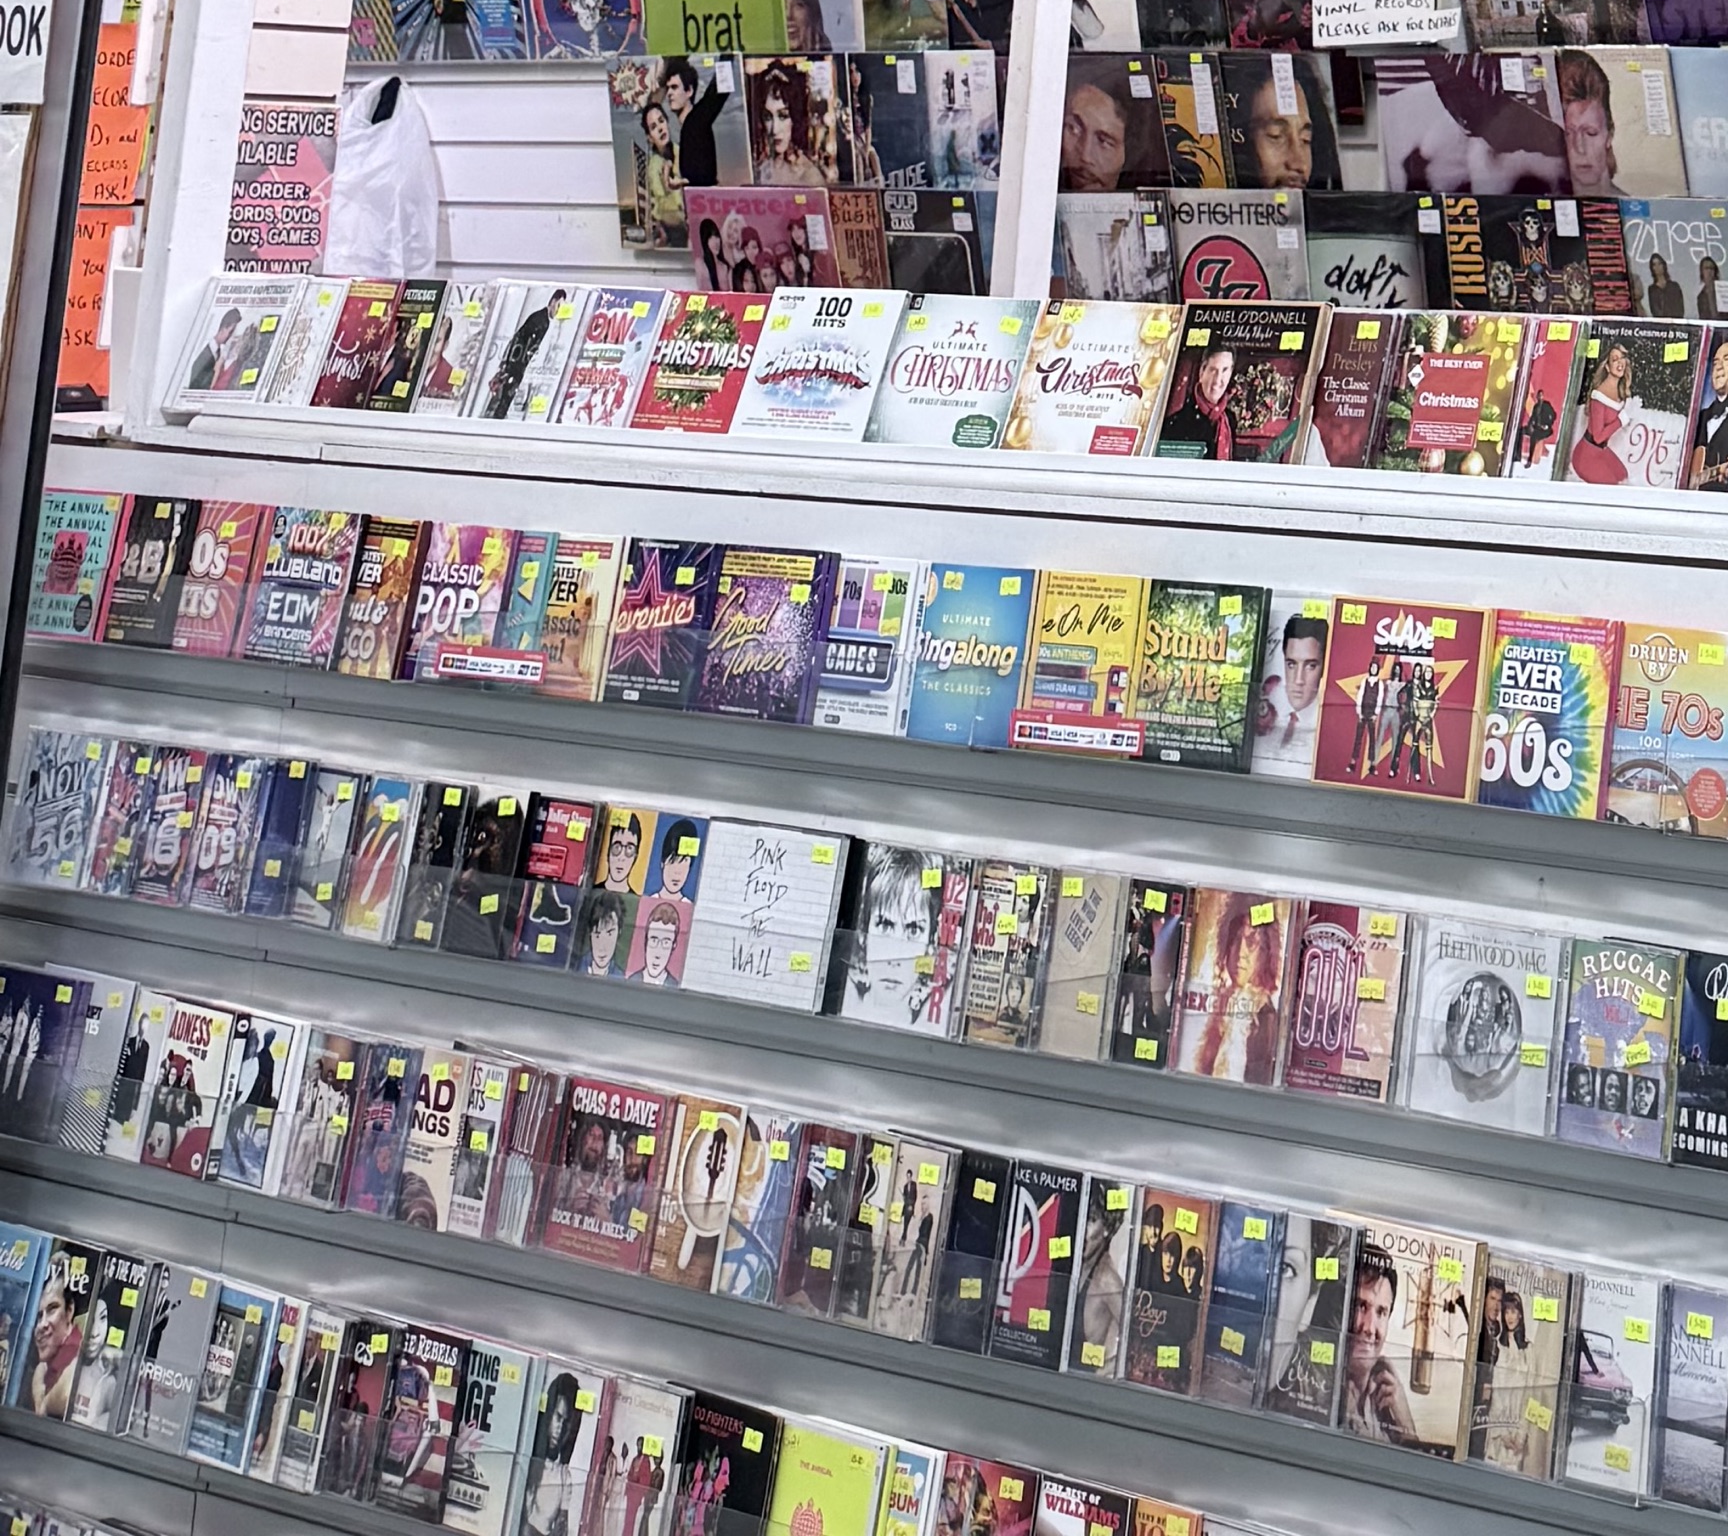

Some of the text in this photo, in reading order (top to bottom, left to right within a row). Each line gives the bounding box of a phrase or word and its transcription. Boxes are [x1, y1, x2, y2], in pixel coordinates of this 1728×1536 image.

[1314, 2, 1366, 16] VINYL
[682, 1, 744, 54] brat
[1318, 21, 1399, 37] PLEASE ASK
[815, 296, 852, 318] 100
[1195, 310, 1307, 325] DANIEL O'DONNELL
[812, 317, 846, 328] HITS
[652, 340, 754, 370] CHRISTMAS
[932, 341, 987, 352] ULTIMATE
[1349, 338, 1378, 353] Elvis
[889, 345, 1014, 395] CHRISTMAS
[1333, 354, 1374, 372] Presley
[1323, 377, 1370, 391] The Classic
[1324, 391, 1368, 405] Christmas
[1334, 405, 1365, 417] Album
[1419, 392, 1479, 408] Christmas
[422, 561, 484, 587] CLASSIC
[416, 586, 481, 634] POP
[1146, 620, 1229, 661] Stand
[1373, 615, 1435, 650] SLADE
[722, 644, 788, 684] Times
[1504, 646, 1566, 663] GREATEST
[1629, 644, 1689, 664] DRIVEN
[1501, 664, 1563, 690] EVER
[1501, 693, 1559, 710] DECADE
[1662, 692, 1724, 740] 70s
[1480, 714, 1574, 792] 60s
[749, 838, 788, 870] PINK
[745, 874, 788, 910] FLOYD
[732, 944, 773, 978] WALL
[1583, 950, 1671, 993] REGGAE
[572, 1086, 660, 1128] CHAS DAVE
